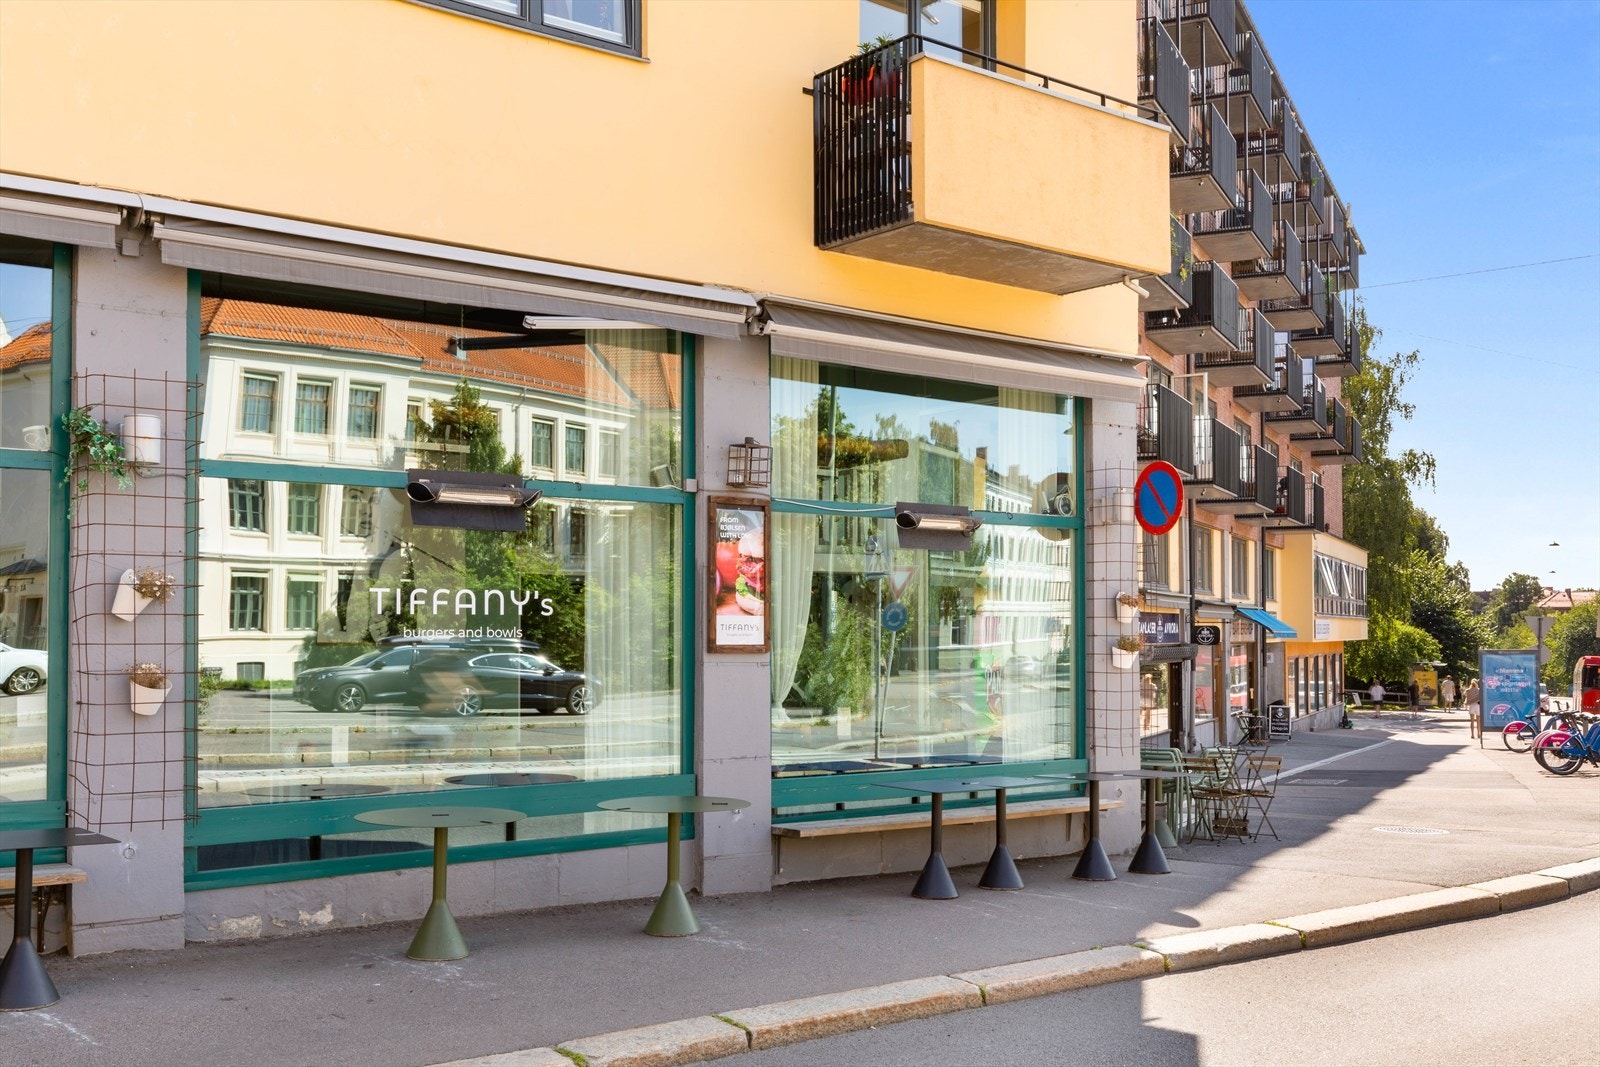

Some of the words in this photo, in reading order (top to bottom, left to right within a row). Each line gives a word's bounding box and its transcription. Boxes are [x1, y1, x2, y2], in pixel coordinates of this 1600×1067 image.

[719, 516, 739, 524] FROM
[403, 626, 455, 640] burgers
[459, 626, 483, 638] and
[487, 626, 523, 638] bowls
